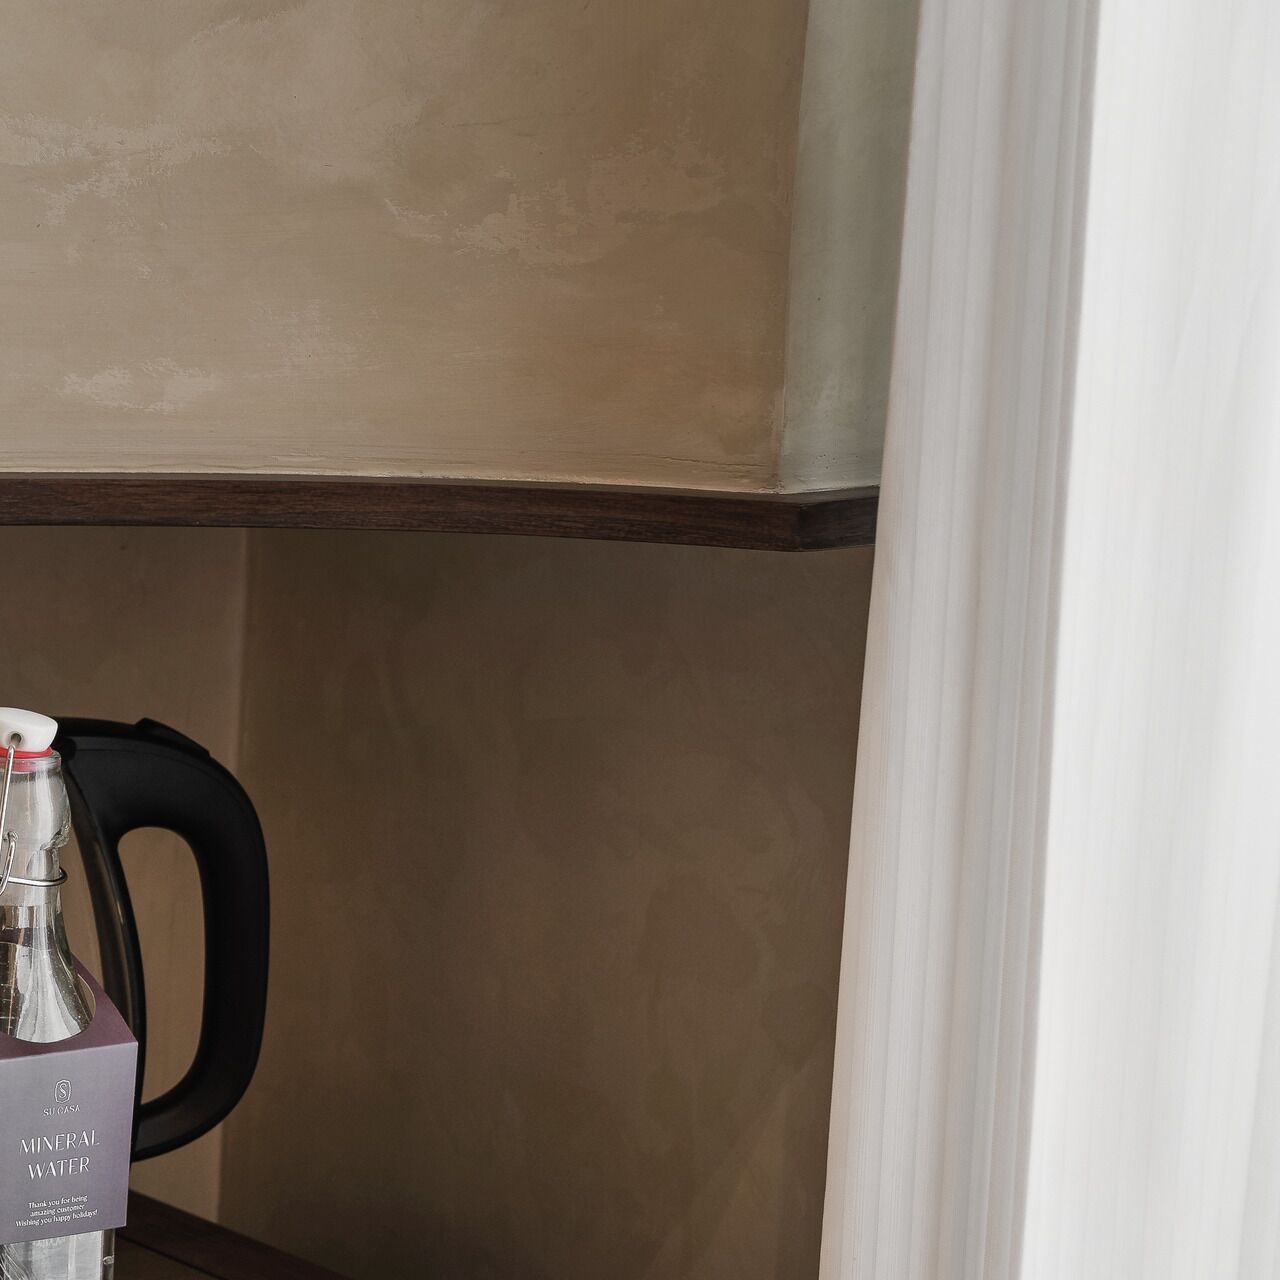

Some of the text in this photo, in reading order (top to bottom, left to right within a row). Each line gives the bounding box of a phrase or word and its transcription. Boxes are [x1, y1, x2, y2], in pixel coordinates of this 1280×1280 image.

[57, 1104, 81, 1115] CASA
[19, 1129, 100, 1155] MINERAL
[28, 1156, 90, 1180] WATER
[28, 1200, 47, 1209] Thank
[48, 1199, 60, 1208] you
[30, 1204, 85, 1217] amazing customer
[15, 1218, 40, 1227] Wishing
[40, 1217, 53, 1226] you
[53, 1214, 71, 1223] happy
